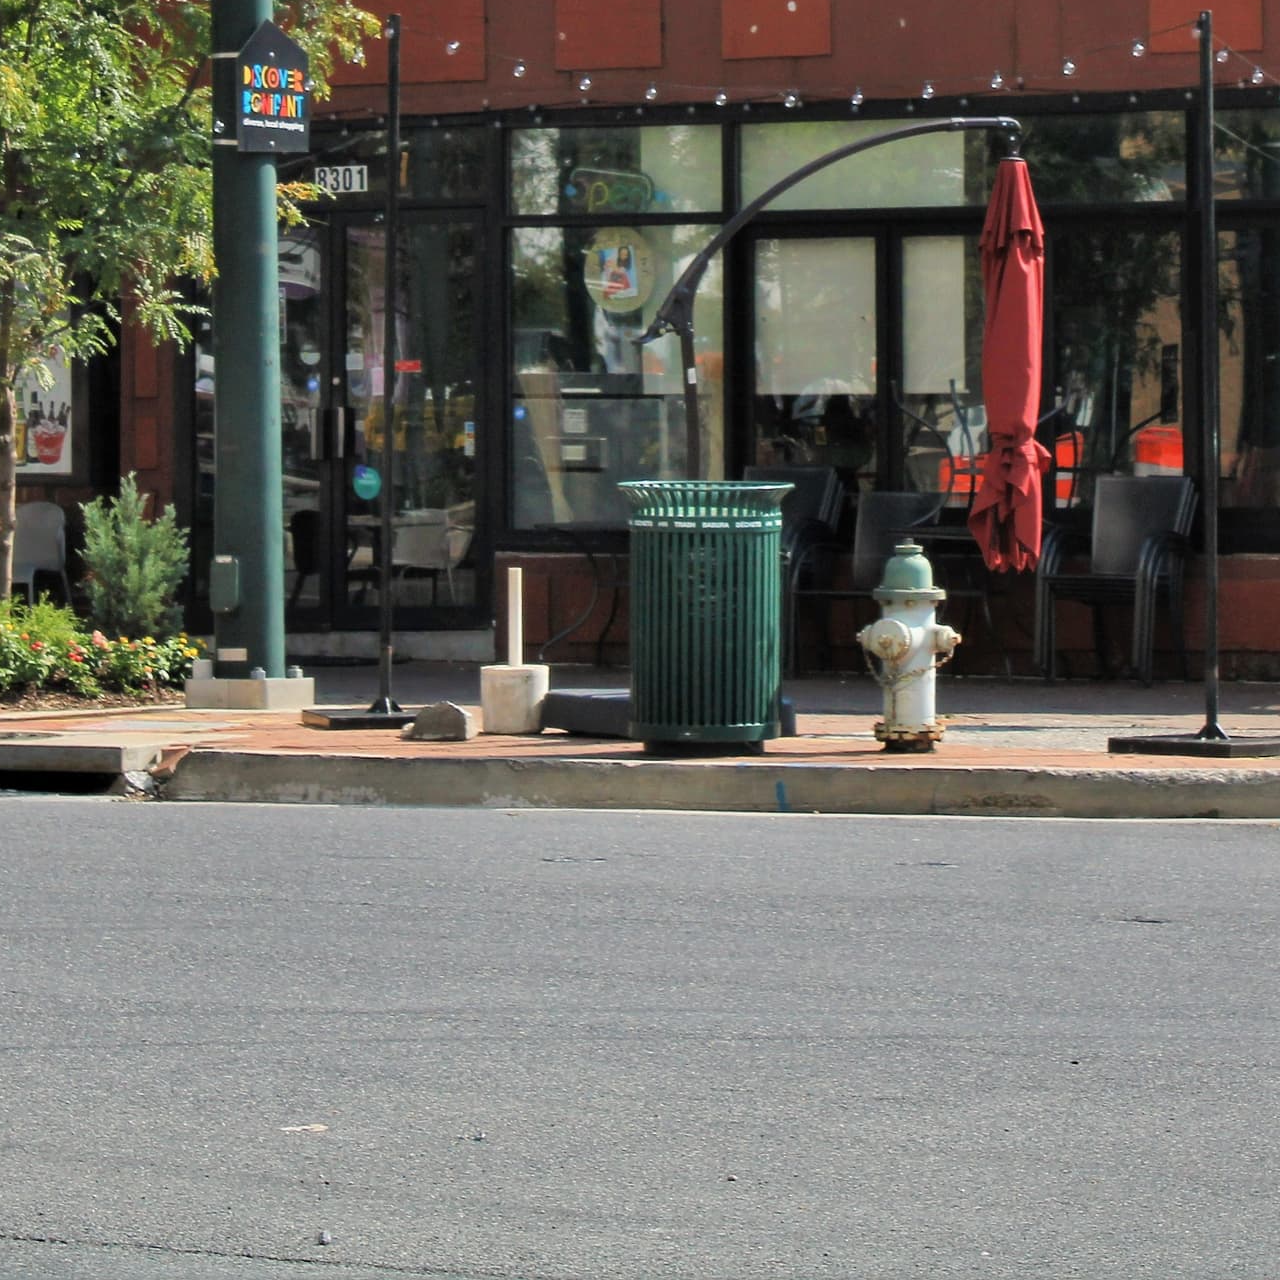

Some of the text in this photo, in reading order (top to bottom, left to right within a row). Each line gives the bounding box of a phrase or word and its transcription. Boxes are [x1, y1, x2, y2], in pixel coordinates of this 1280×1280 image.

[243, 64, 305, 93] DISCOVER
[242, 90, 305, 118] BONIFANT
[317, 167, 365, 192] 8301
